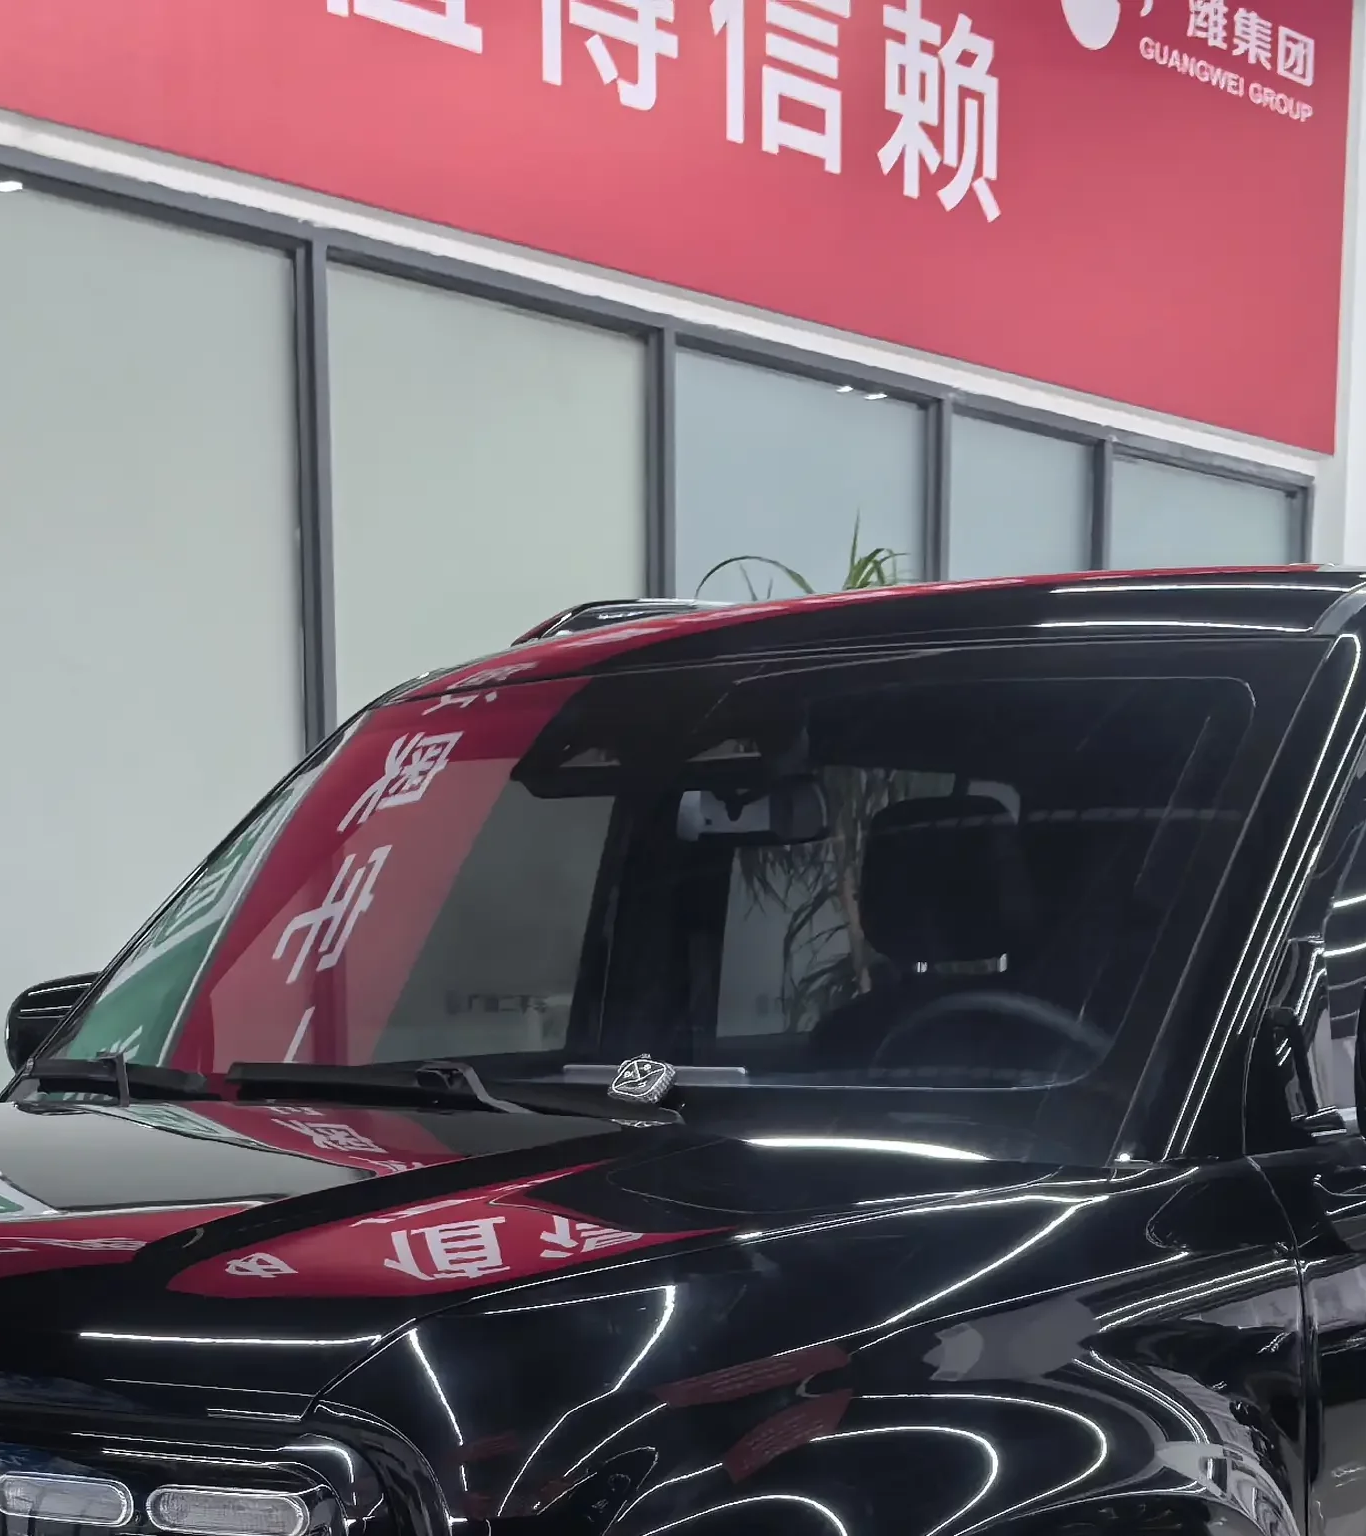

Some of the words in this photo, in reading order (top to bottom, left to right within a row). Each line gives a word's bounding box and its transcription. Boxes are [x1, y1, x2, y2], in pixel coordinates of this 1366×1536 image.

[1139, 0, 1315, 87] 潍集团
[1139, 36, 1245, 98] GUANGWEI
[1248, 82, 1314, 123] GROUP
[326, 0, 1002, 223] 信赖
